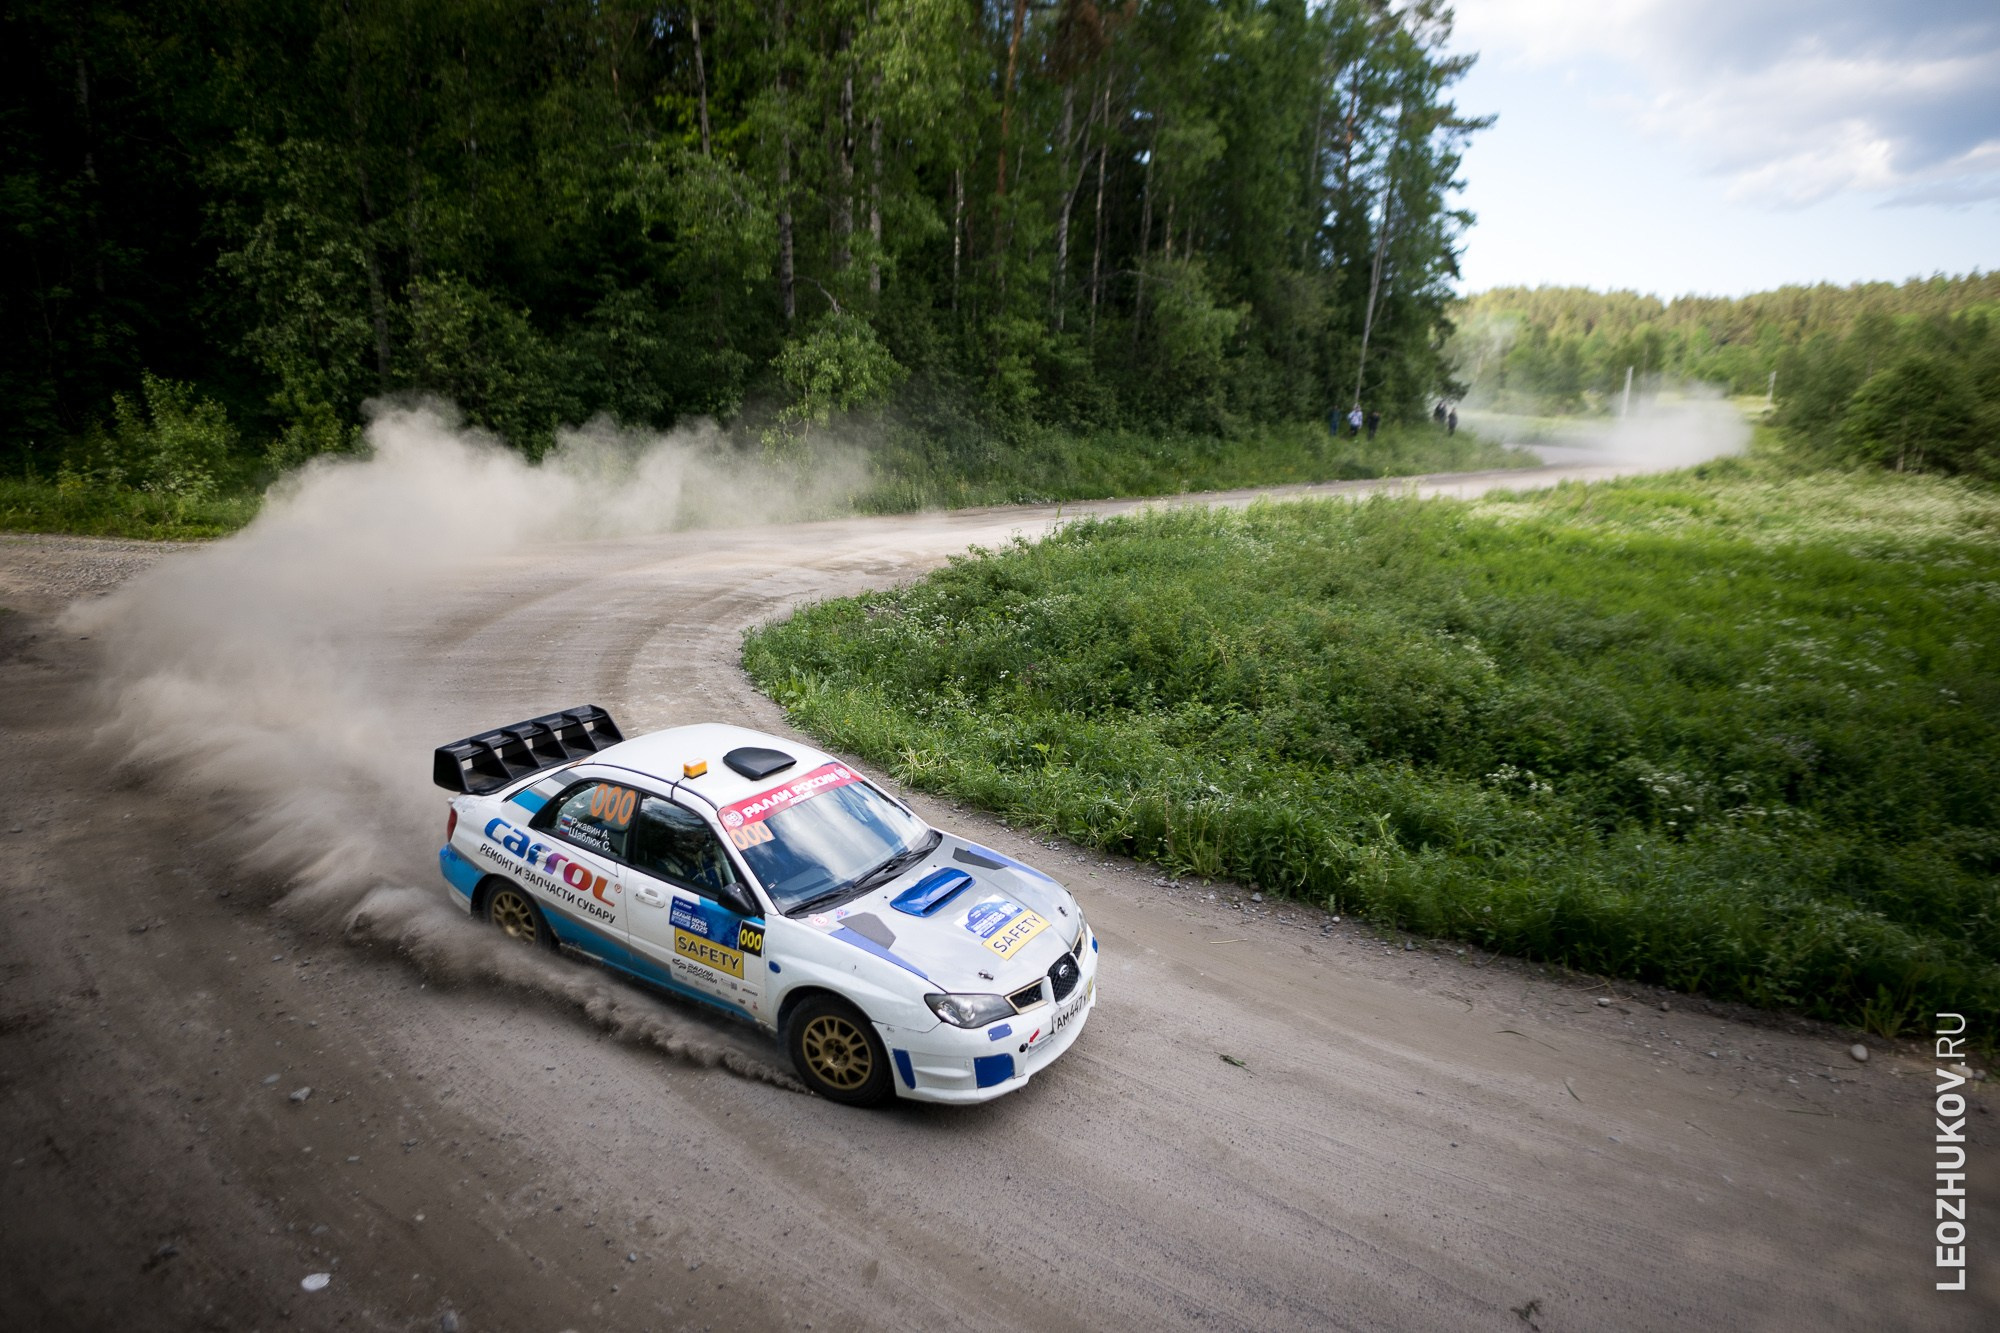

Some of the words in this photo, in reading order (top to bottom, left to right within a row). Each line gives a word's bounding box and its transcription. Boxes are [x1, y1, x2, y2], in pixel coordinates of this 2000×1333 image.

[590, 783, 636, 825] 000
[741, 788, 793, 818] РАЛЛИ
[791, 772, 841, 796] РОССИИ
[568, 826, 601, 849] Шаблюк
[570, 817, 602, 836] Ржавин
[479, 843, 516, 873] РЕМОНТ
[513, 864, 523, 876] И
[523, 869, 575, 904] ЗАПЧАСТИ
[576, 897, 616, 923] СУБАРУ
[739, 928, 763, 951] 000
[993, 914, 1042, 953] SAFETY
[677, 936, 741, 970] SAFETY
